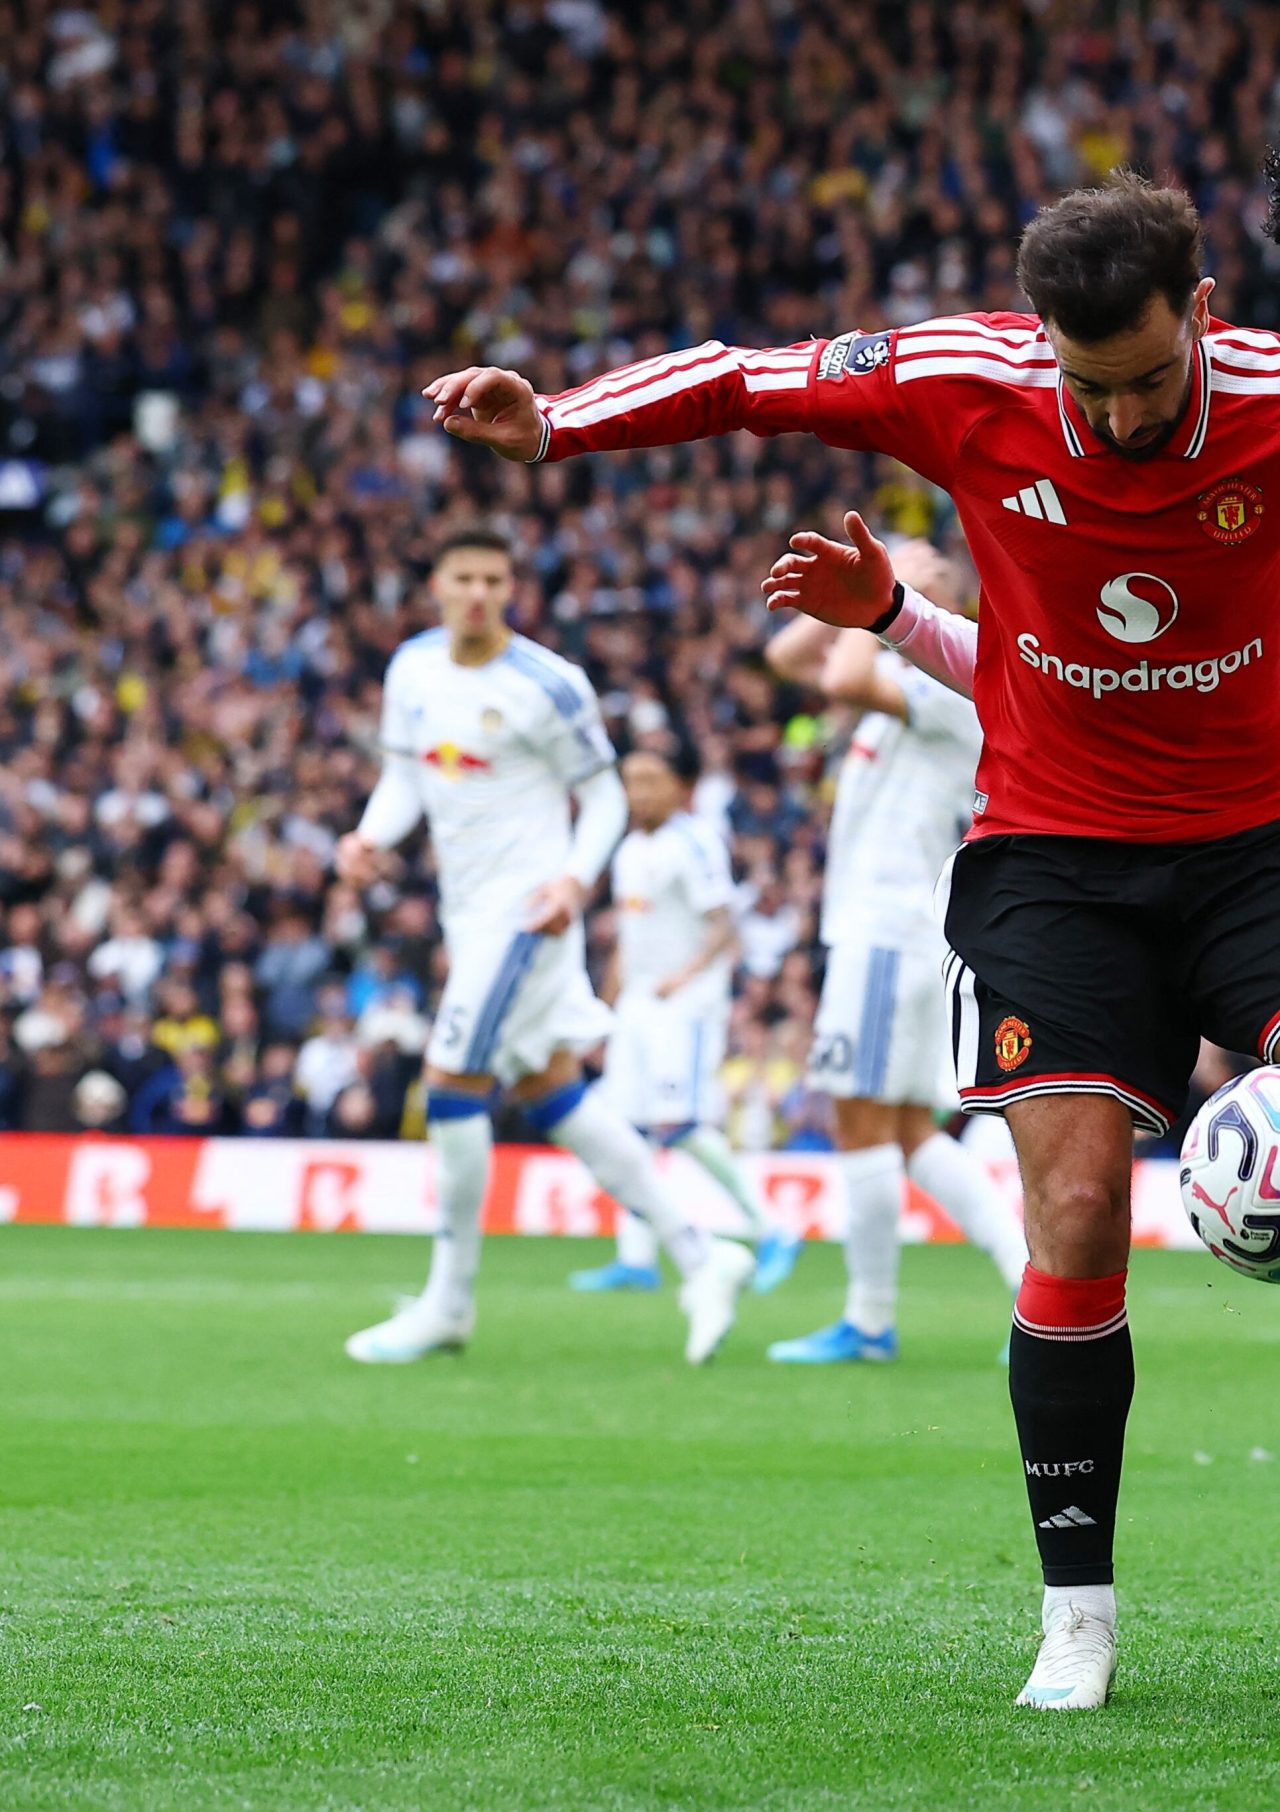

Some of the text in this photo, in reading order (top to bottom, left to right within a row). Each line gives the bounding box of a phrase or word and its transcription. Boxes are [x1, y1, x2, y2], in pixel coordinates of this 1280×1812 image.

[1213, 525, 1252, 541] UNITED
[1017, 632, 1264, 699] Snapdragon
[1025, 1459, 1094, 1477] MUFC
